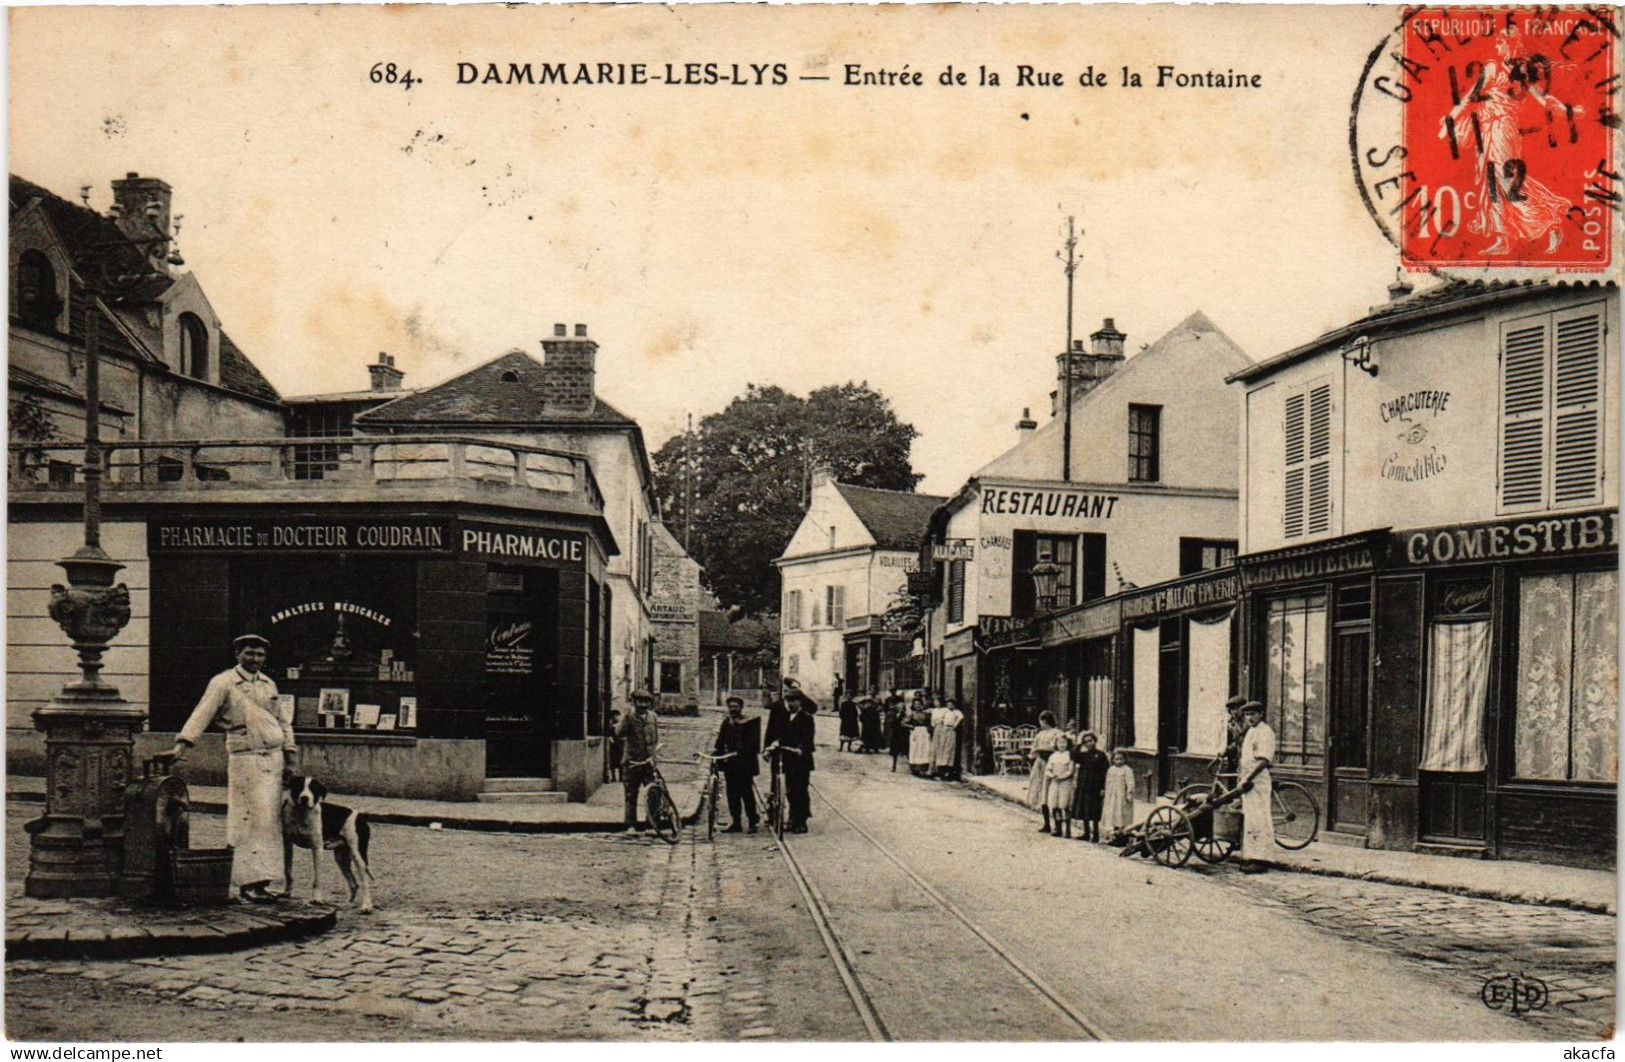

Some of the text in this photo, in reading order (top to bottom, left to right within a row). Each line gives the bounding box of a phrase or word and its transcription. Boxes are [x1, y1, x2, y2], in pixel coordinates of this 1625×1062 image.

[1380, 390, 1450, 423] CHARCUTERIE
[981, 488, 1119, 519] RESTAURANT
[160, 526, 252, 546] PHARMACIE
[273, 526, 347, 546] DOCTEUR
[357, 526, 442, 547] COUDRAIN
[462, 529, 583, 561] PHARMACIE
[271, 601, 325, 624] ANALYSES
[980, 616, 1025, 637] VINS
